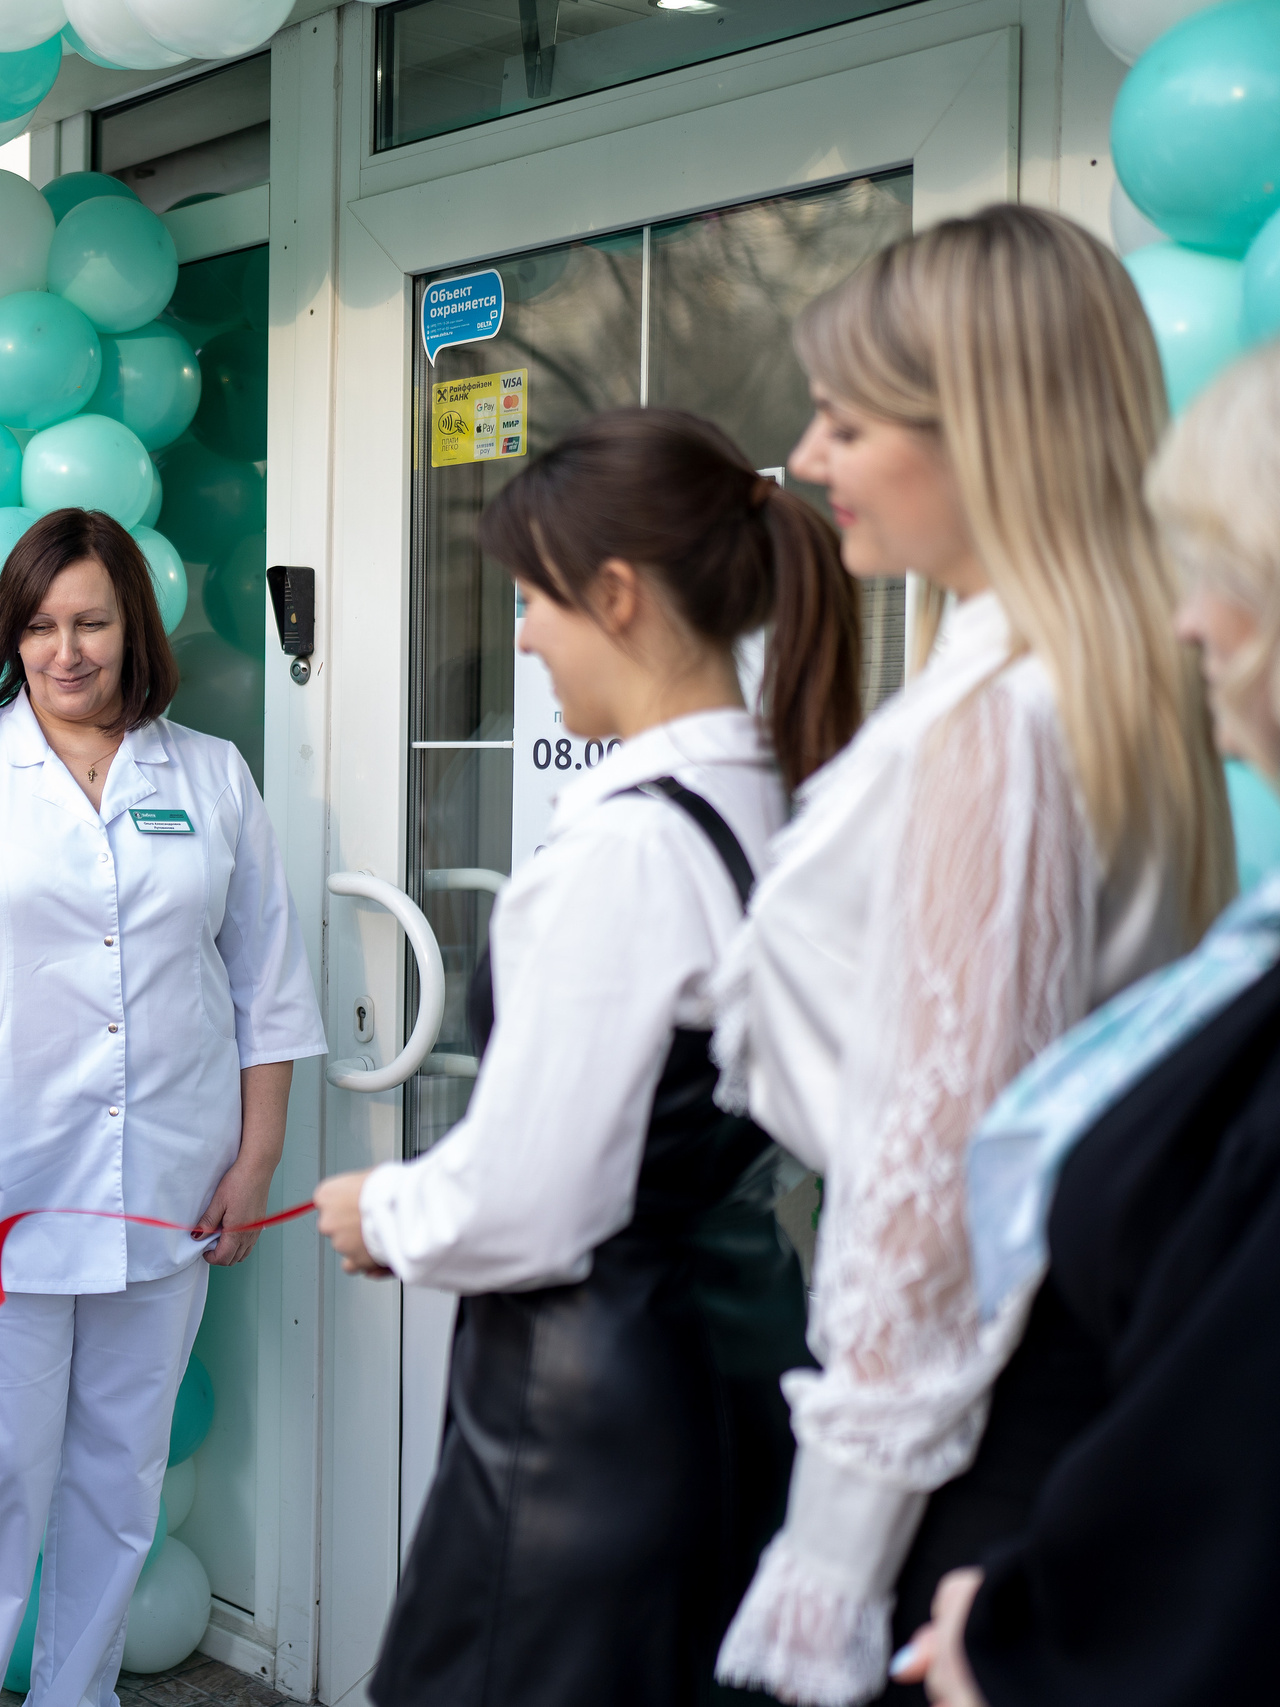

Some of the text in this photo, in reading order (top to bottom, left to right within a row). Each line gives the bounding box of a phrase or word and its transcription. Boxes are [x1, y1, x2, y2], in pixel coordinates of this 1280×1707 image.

[430, 286, 472, 304] Объект
[430, 295, 496, 318] охраняется
[477, 320, 492, 329] DELTA
[449, 381, 492, 393] Райффайзен
[502, 377, 522, 388] VISA
[449, 393, 469, 402] БАНК
[484, 403, 494, 411] Pay
[483, 424, 494, 434] Pay
[502, 420, 519, 429] МИР
